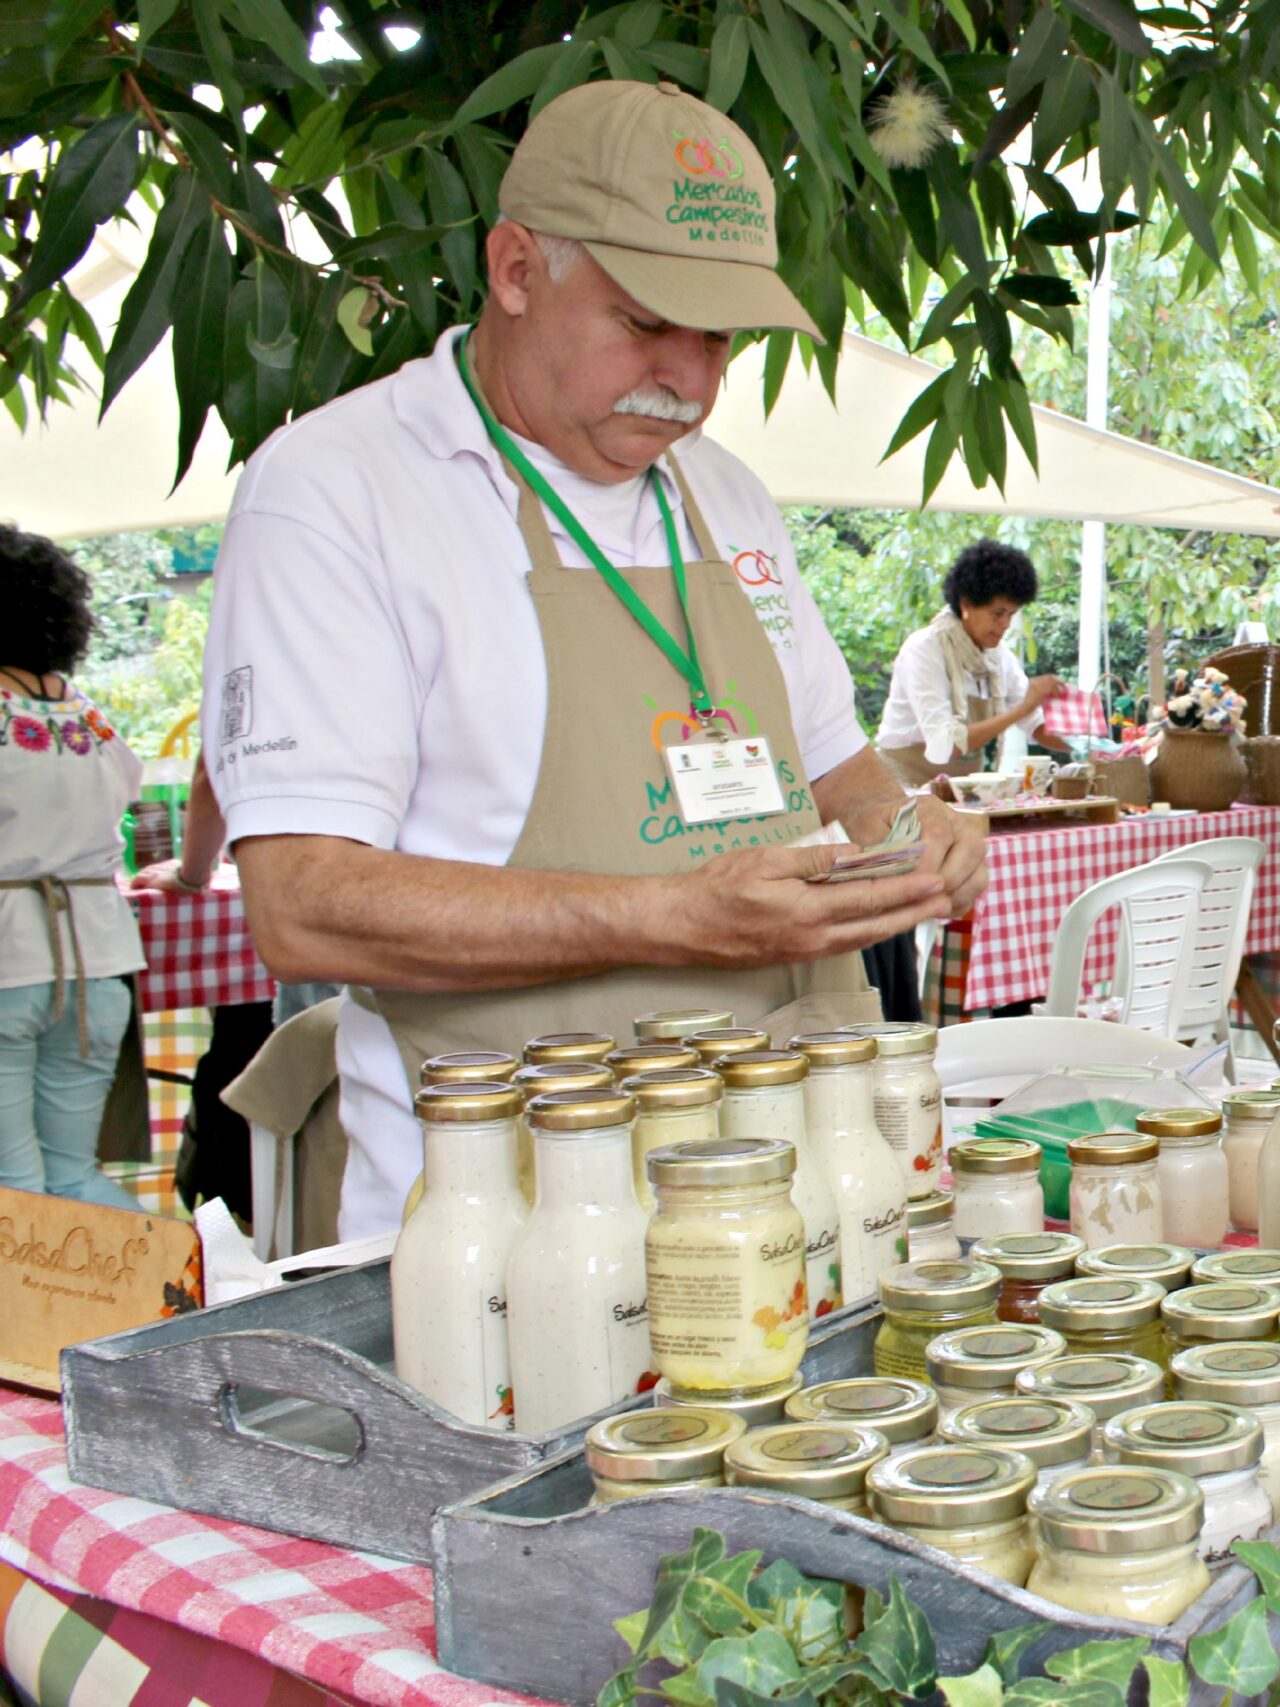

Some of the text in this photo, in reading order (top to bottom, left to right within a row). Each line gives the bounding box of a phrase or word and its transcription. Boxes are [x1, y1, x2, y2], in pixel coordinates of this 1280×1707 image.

[665, 203, 768, 233] Campesinos
[242, 736, 298, 758] Medellín
[613, 1297, 649, 1322] Salsa
